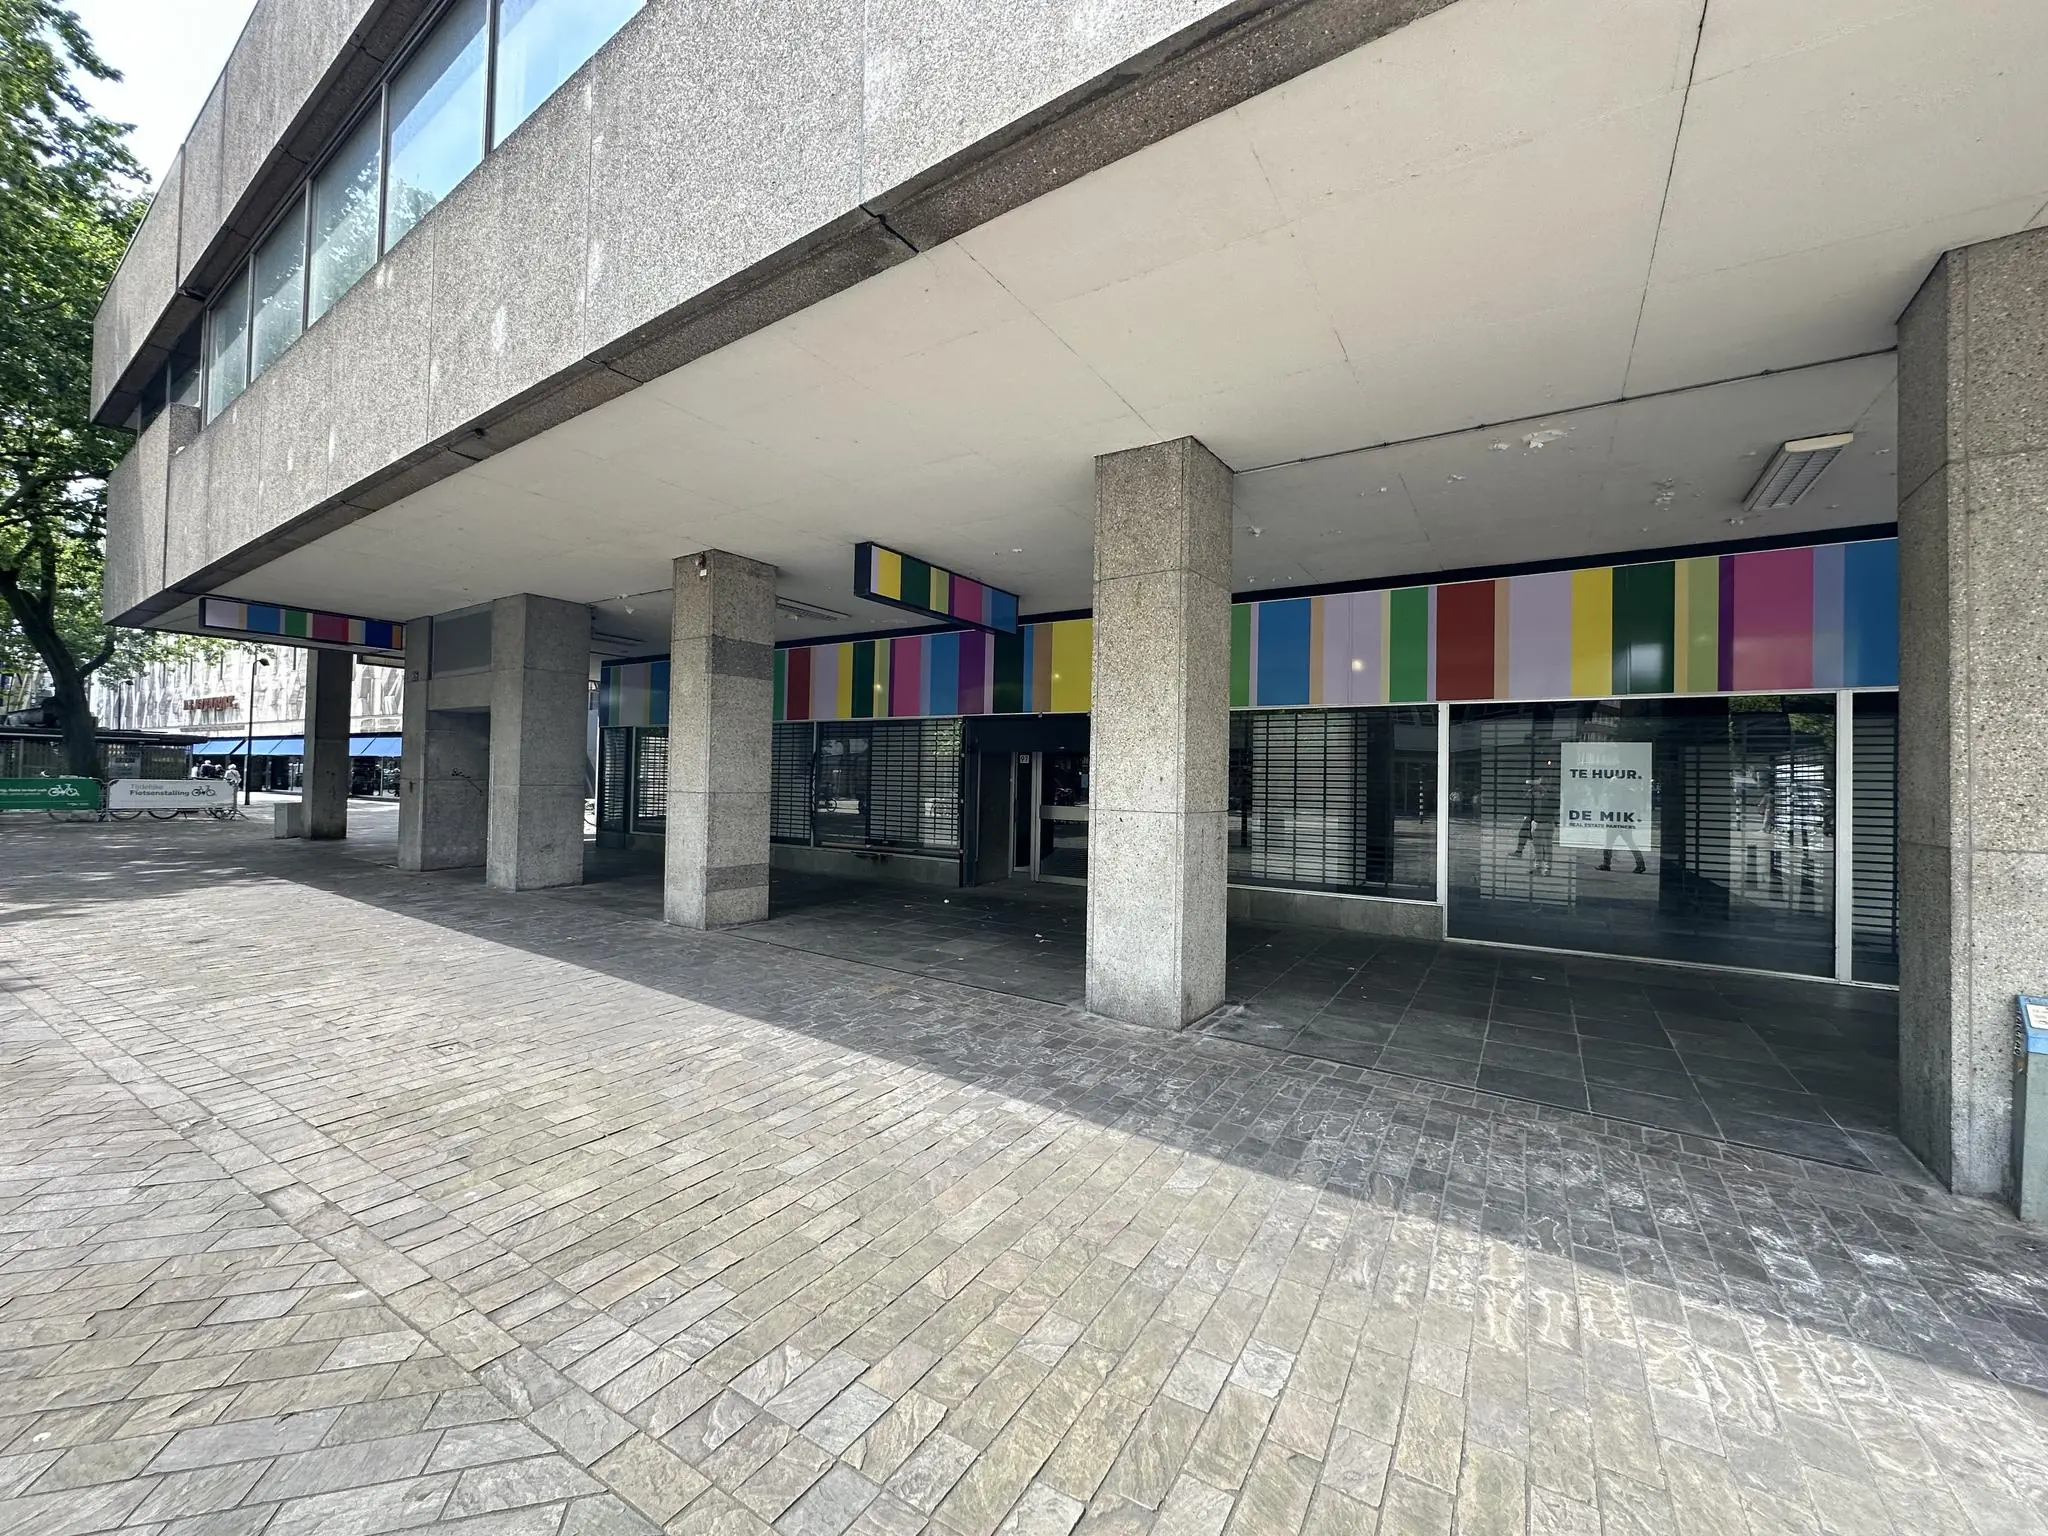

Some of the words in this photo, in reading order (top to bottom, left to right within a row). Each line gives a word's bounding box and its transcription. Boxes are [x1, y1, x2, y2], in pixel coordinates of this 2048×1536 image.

[1570, 769, 1587, 778] TE
[1592, 769, 1642, 779] HUUR.
[1569, 810, 1592, 821] DE
[1600, 811, 1642, 822] MIK.
